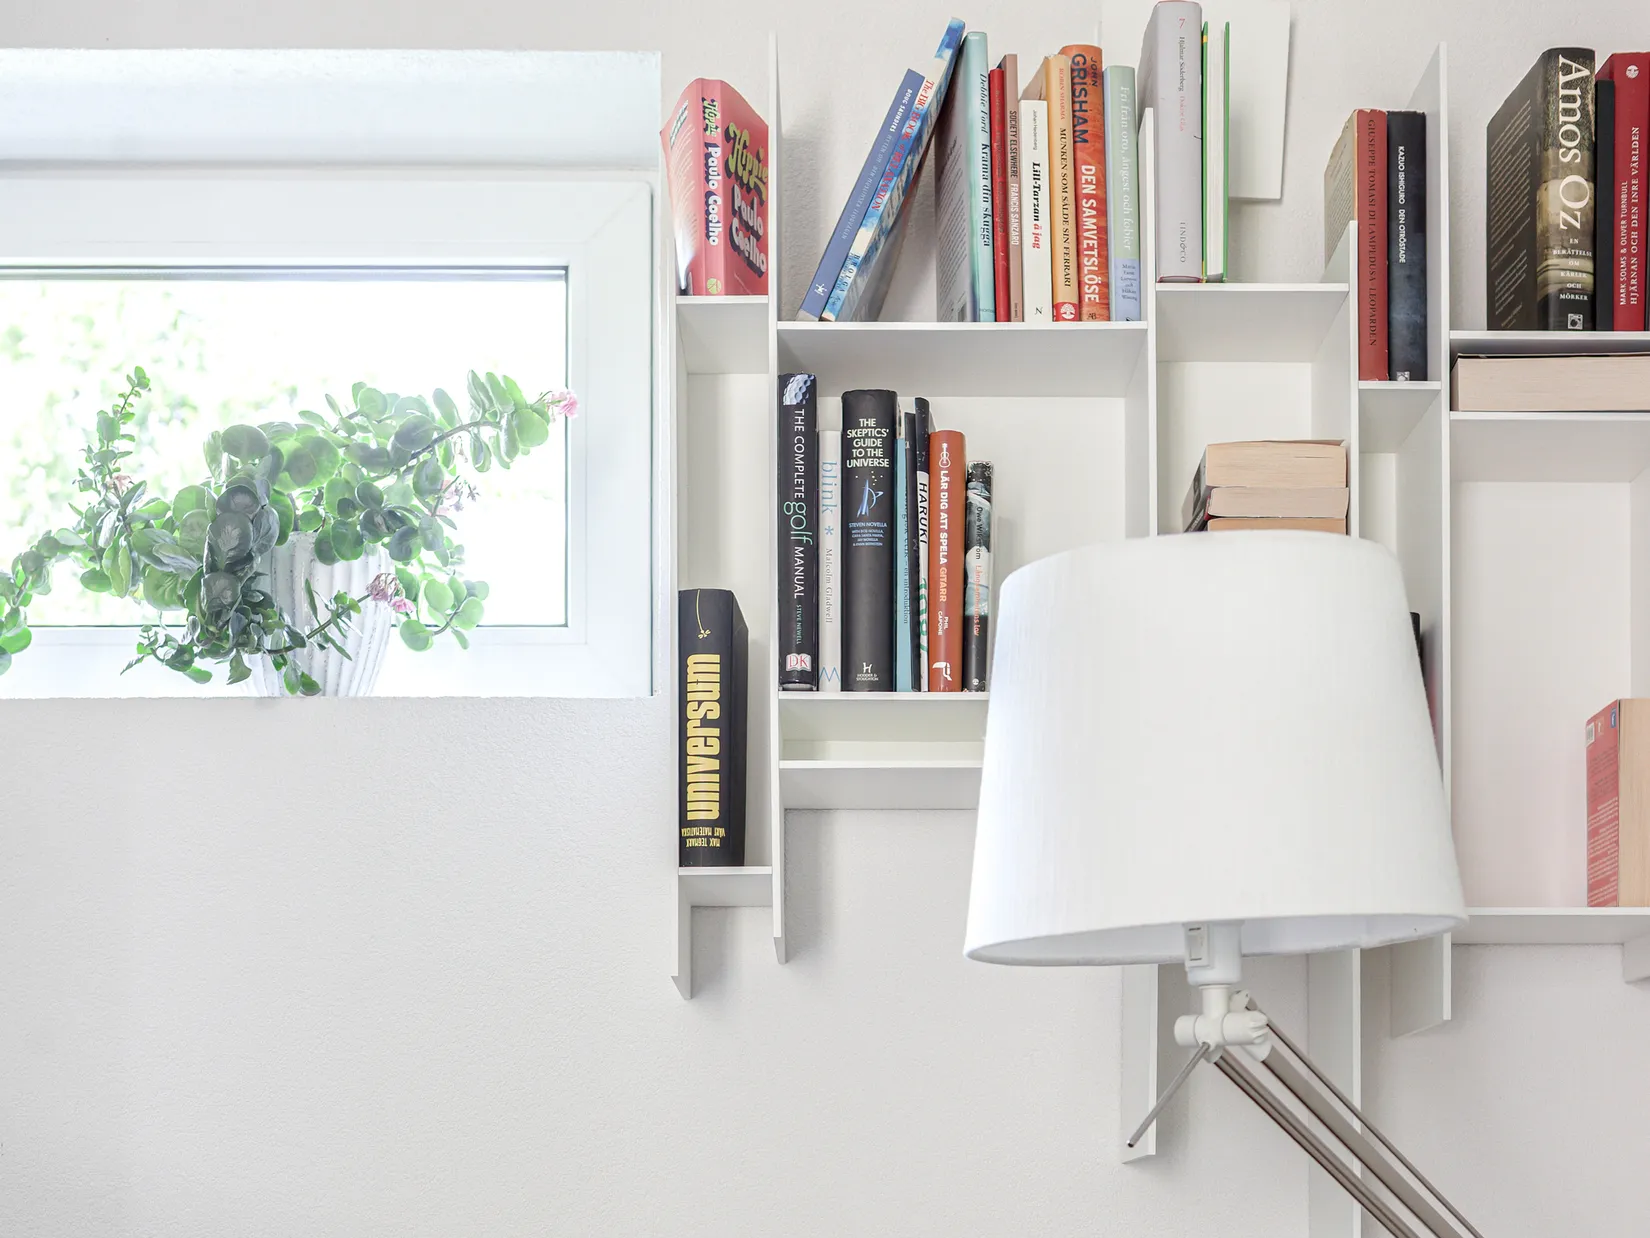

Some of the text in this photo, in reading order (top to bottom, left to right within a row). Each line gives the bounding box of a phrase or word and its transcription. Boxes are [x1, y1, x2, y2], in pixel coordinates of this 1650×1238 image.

[1090, 56, 1098, 87] JOHN
[1178, 36, 1186, 92] Hjalmar Söderberg
[914, 93, 928, 111] BIG
[921, 79, 934, 95] The
[980, 73, 989, 134] Debbie Ford
[1071, 53, 1088, 144] GRISHAM
[1559, 53, 1591, 163] Amos
[702, 98, 721, 137] Hippie
[888, 88, 913, 132] DOUG SAUNDERS
[900, 111, 920, 142] BOOK
[725, 122, 768, 203] Hippie
[1009, 110, 1018, 178] SOCIETY ELSEWHERE
[1060, 128, 1068, 166] MUNKEN
[1630, 126, 1640, 175] VÄRLDEN
[870, 151, 903, 211] RELAXATION
[1119, 86, 1134, 250] Fri från oro, ångest och fobier
[1368, 168, 1376, 206] TOMASI
[1398, 146, 1406, 204] KAZUO ISHIGURO
[705, 143, 722, 246] Paulo Coelho
[732, 184, 764, 240] Paulo
[980, 143, 992, 247] Krama din skugga
[1032, 162, 1042, 222] Lill-Tarzan
[1062, 195, 1072, 226] SÅLDE
[1631, 178, 1639, 203] INRE
[1010, 184, 1019, 246] FRANCIS SANZARO
[1082, 165, 1102, 303] DEN SAMVETSLÖSE
[1368, 210, 1376, 220] DI
[1620, 220, 1628, 246] OLIVER
[1631, 206, 1639, 227] DEN
[729, 217, 767, 277] Coelho
[1032, 232, 1042, 249] jag
[1399, 225, 1407, 264] OTRÖSTADE
[1063, 246, 1072, 288] FERRARI
[1560, 270, 1588, 278] KÄRLEK
[1630, 257, 1639, 305] HJÄRNAN
[1560, 292, 1588, 300] MÖRKER
[846, 428, 889, 438] SKEPTICS'
[853, 438, 882, 448] GUIDE
[858, 418, 876, 427] THE
[846, 458, 890, 468] UNIVERSE
[852, 448, 884, 458] TO THE
[784, 408, 812, 598] THE COMPLETE golf MANUAL
[821, 461, 837, 514] blink
[919, 482, 928, 544] HARUKI
[939, 470, 950, 602] LÄR DIG ATT SPELA GITARR
[825, 548, 833, 623] Malcolm Gladwell
[789, 655, 808, 668] DK
[710, 838, 721, 848] MAX
